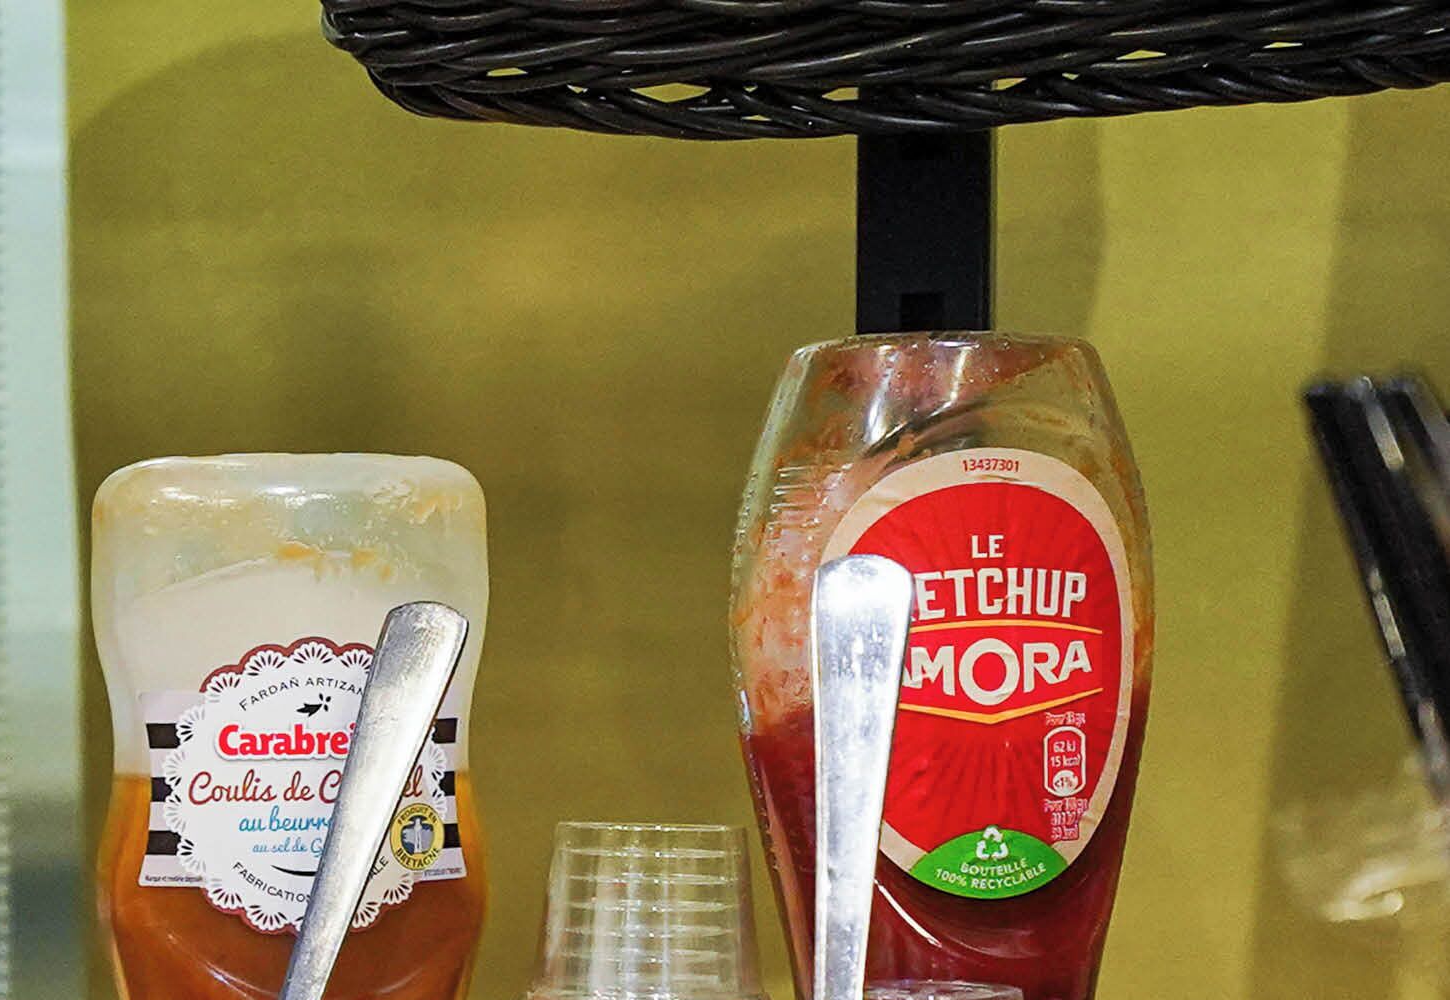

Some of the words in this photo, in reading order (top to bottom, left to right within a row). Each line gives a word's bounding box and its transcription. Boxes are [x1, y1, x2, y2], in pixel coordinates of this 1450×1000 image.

[962, 458, 1020, 473] 13437301
[971, 534, 1004, 559] LE
[910, 567, 1087, 622] ETCHUP
[188, 769, 277, 805] Coulis
[283, 772, 315, 801] de
[239, 817, 265, 831] au
[270, 805, 331, 831] beurr
[935, 868, 967, 888] 100%
[971, 863, 1047, 889] RECYCLABLE
[960, 858, 1028, 874] BOUTEILLE
